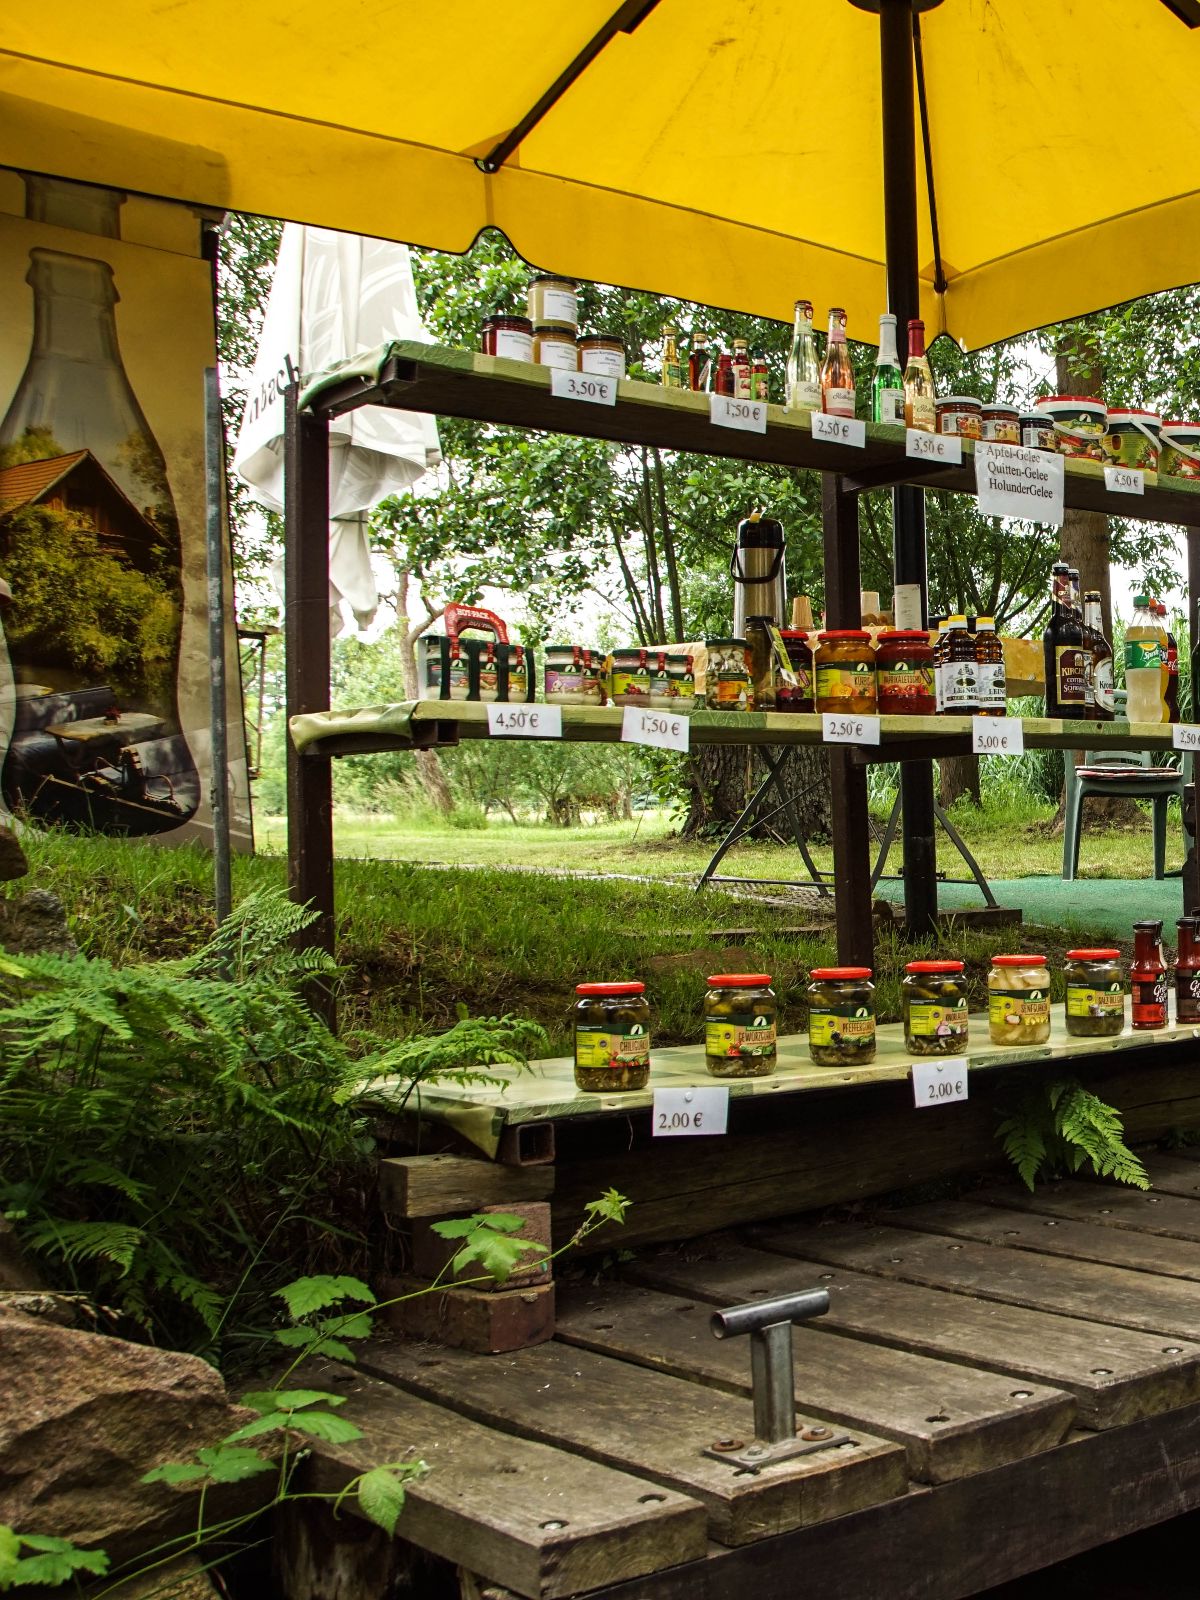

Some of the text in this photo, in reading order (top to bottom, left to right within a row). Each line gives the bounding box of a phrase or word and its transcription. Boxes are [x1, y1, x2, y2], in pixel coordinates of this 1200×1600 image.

[568, 379, 609, 399] 3,50 €
[725, 402, 760, 421] 1,50 €
[817, 420, 850, 437] 2,50 €
[913, 438, 945, 455] 3,50 €
[986, 445, 1041, 464] Apfel-Gelee
[987, 461, 1049, 481] Quitten-Gelee
[989, 478, 1053, 499] HolunderGelee
[1133, 477, 1139, 487] €
[496, 712, 539, 728] 4,50 €
[640, 718, 680, 735] 1,50 €
[830, 722, 864, 737] 2,50 €
[977, 736, 1008, 750] 5,00 €
[928, 1081, 963, 1100] 2,00 €
[658, 1112, 703, 1130] 2,00 €
